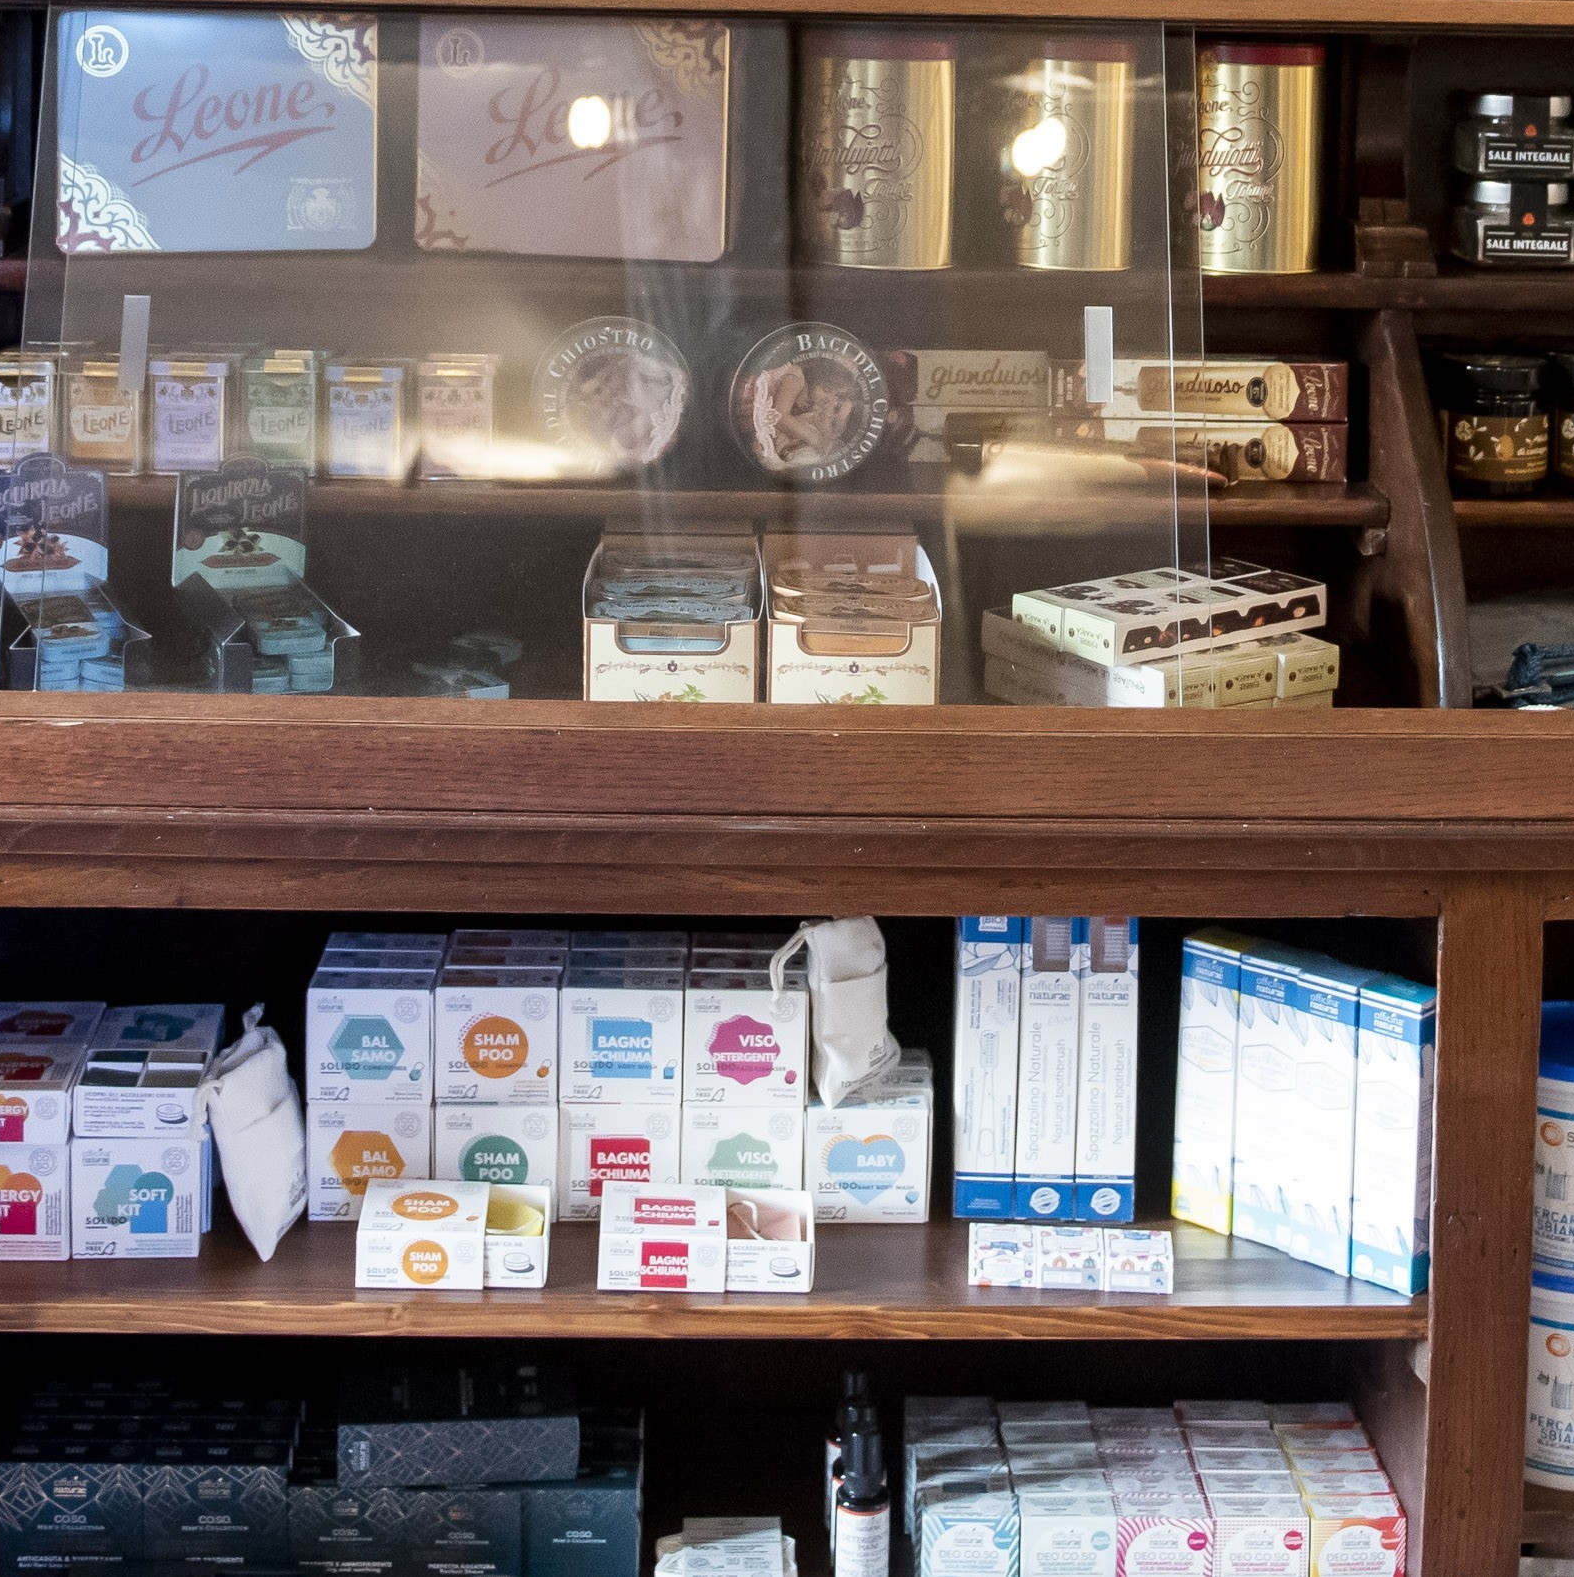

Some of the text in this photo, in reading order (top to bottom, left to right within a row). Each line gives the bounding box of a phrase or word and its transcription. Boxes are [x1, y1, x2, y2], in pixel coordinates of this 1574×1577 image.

[131, 63, 335, 165] Leone
[1489, 151, 1570, 163] SALE INTEGRALE
[549, 327, 655, 377] CHIOSTRO
[796, 333, 888, 482] BACI DEL CHIOSTRO
[82, 413, 129, 435] LEONE
[41, 499, 98, 525] LEONE
[474, 1034, 520, 1045] SHAM
[598, 1035, 652, 1049] BAGNO
[739, 1034, 776, 1047] VISO
[479, 1049, 514, 1061] POO
[592, 1052, 651, 1063] SCHIUMA
[857, 1154, 895, 1167] BABY
[129, 1189, 167, 1201] SOFT
[117, 1204, 140, 1217] KIT
